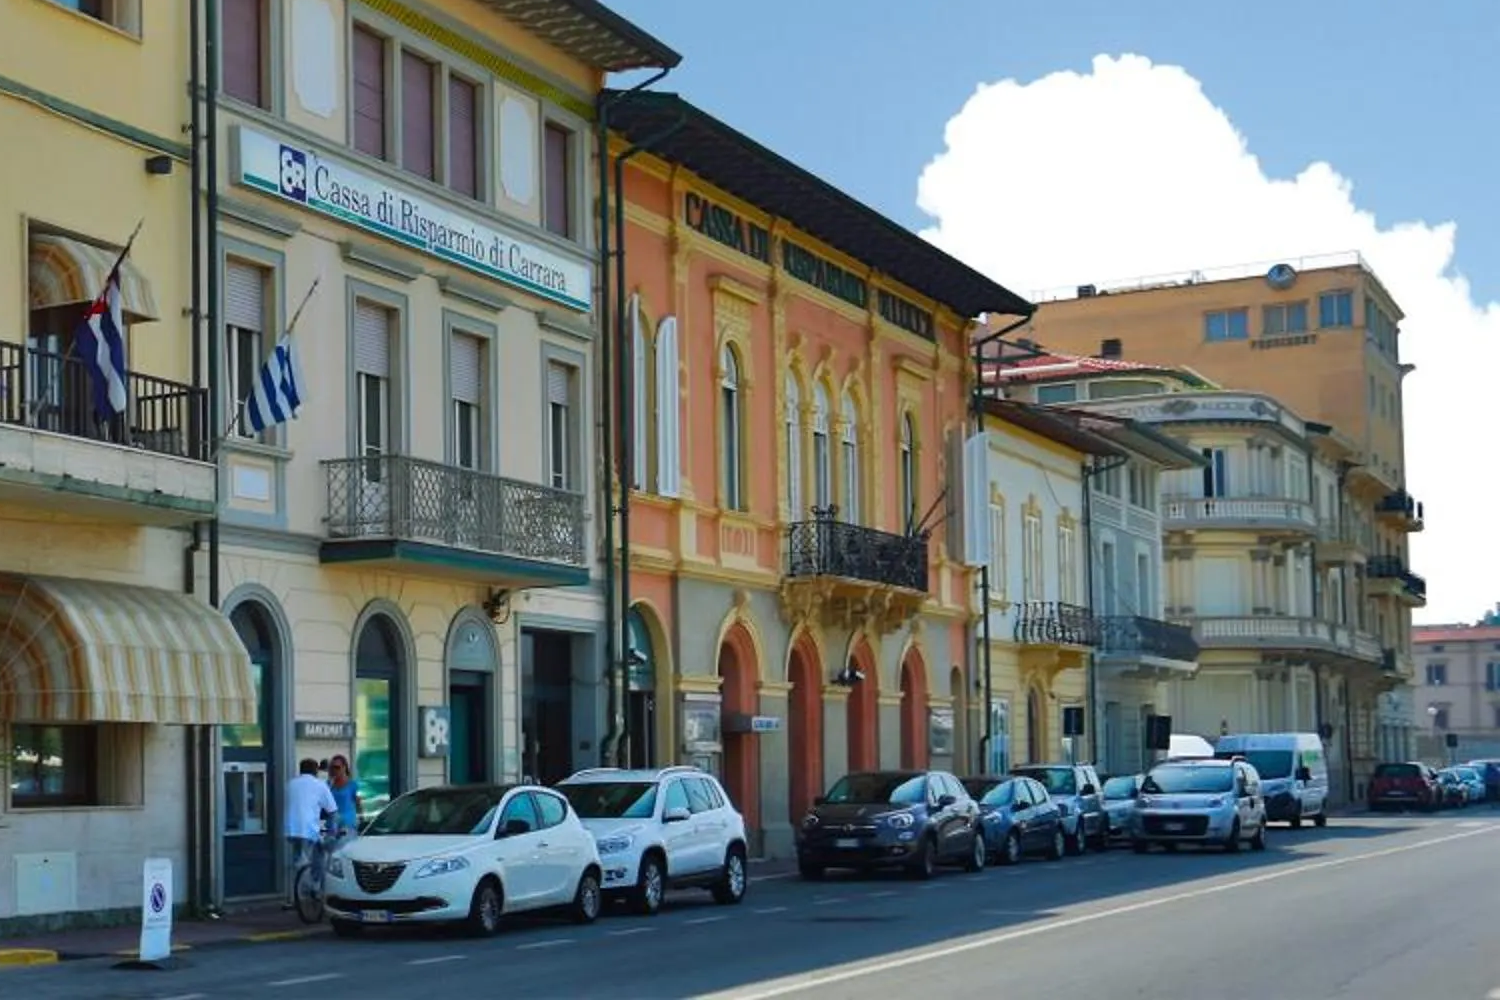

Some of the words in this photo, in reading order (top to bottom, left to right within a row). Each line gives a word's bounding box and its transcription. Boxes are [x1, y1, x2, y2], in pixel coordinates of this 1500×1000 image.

[315, 165, 372, 218] Cassa
[377, 189, 396, 226] di
[400, 199, 486, 264] Risparmio
[489, 236, 506, 267] di
[508, 244, 567, 293] Carrara
